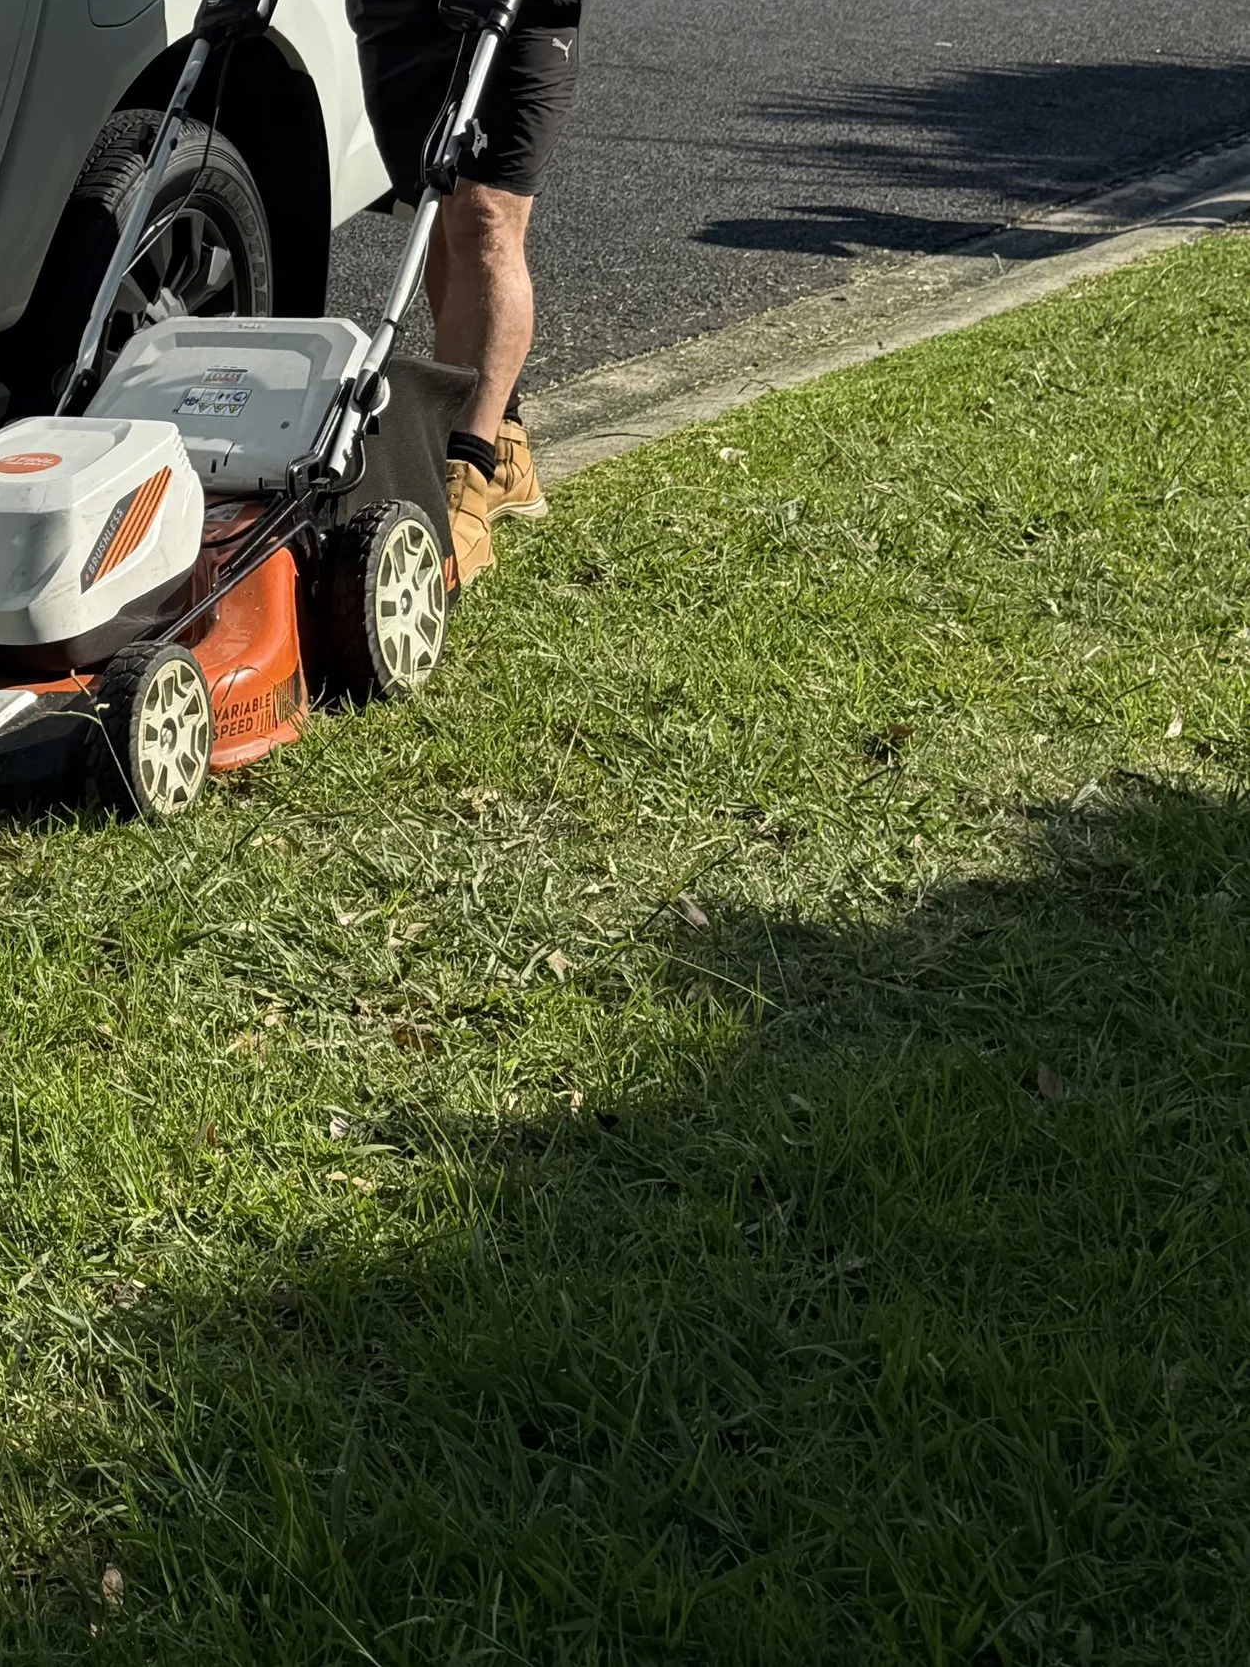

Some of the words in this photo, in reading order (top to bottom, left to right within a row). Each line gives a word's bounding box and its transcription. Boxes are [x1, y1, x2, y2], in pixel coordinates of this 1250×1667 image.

[88, 507, 124, 575] BRUSHLESS
[213, 693, 271, 723] VARIABLE
[212, 717, 253, 741] SPEED
